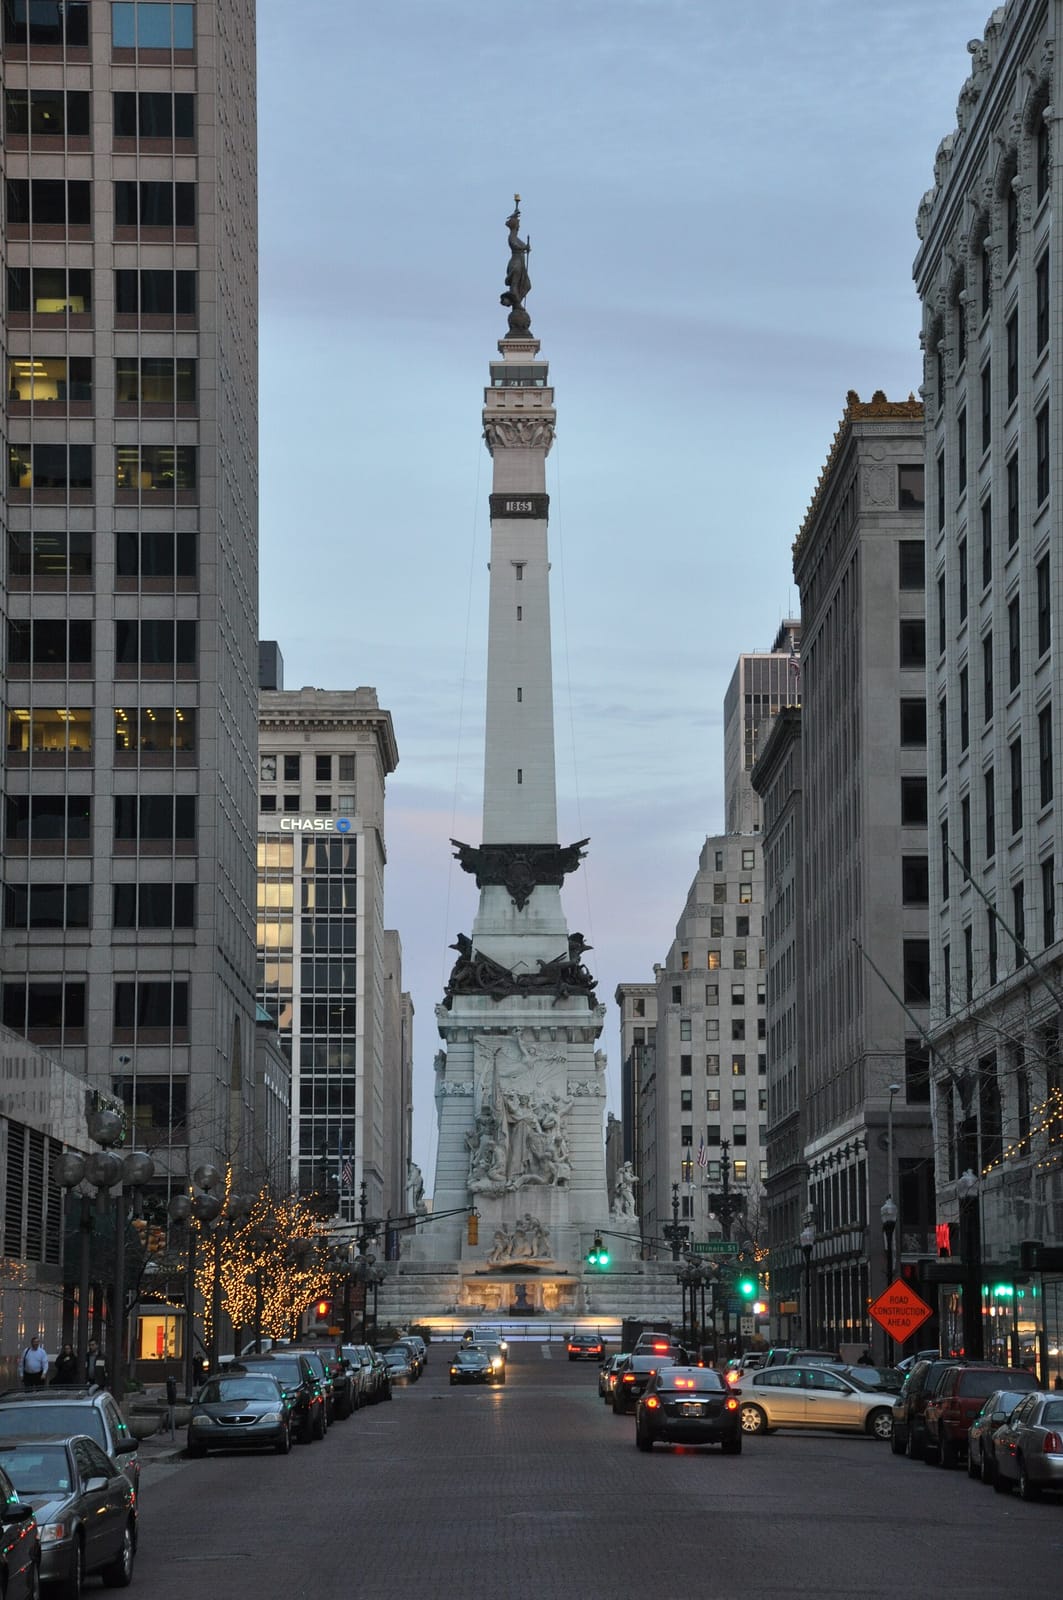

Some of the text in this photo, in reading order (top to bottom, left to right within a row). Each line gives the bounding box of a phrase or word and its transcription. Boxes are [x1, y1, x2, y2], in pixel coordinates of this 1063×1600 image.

[507, 501, 530, 511] 1865
[280, 819, 334, 830] CHASE
[696, 1244, 736, 1252] Illinois St
[889, 1296, 909, 1305] ROAD
[873, 1307, 926, 1316] CONSTRUCTION
[888, 1319, 911, 1328] AHEAD
